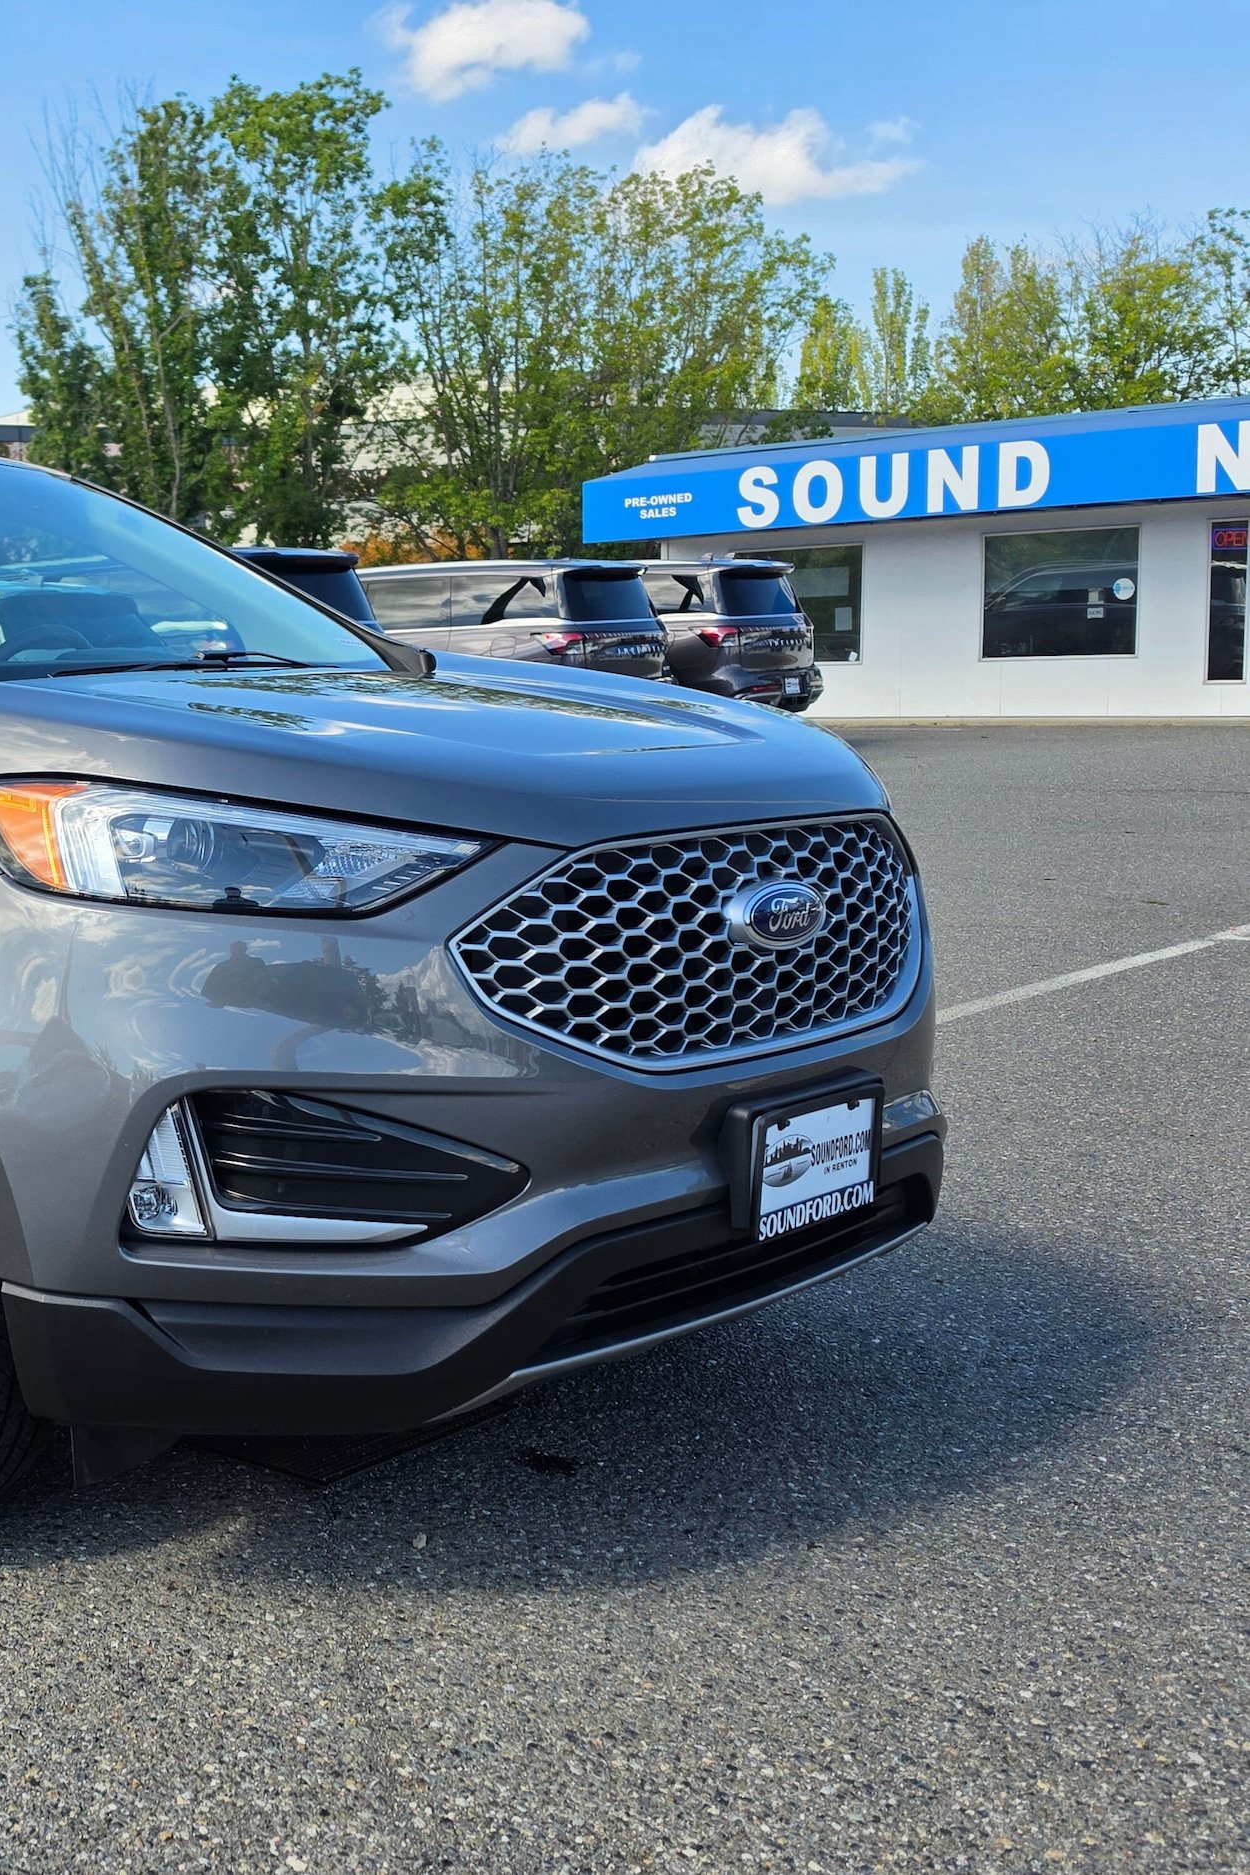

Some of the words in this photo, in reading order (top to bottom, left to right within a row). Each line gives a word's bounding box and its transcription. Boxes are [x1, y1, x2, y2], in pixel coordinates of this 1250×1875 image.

[624, 492, 693, 508] PRE-OWNED
[737, 440, 1051, 529] SOUND
[639, 506, 677, 519] SALES
[768, 896, 812, 932] Ford
[811, 1129, 871, 1167] SOUNDFORD.COM
[824, 1165, 831, 1175] IN
[832, 1157, 858, 1172] RENTON
[758, 1181, 874, 1241] SOUNDFORD.COM
